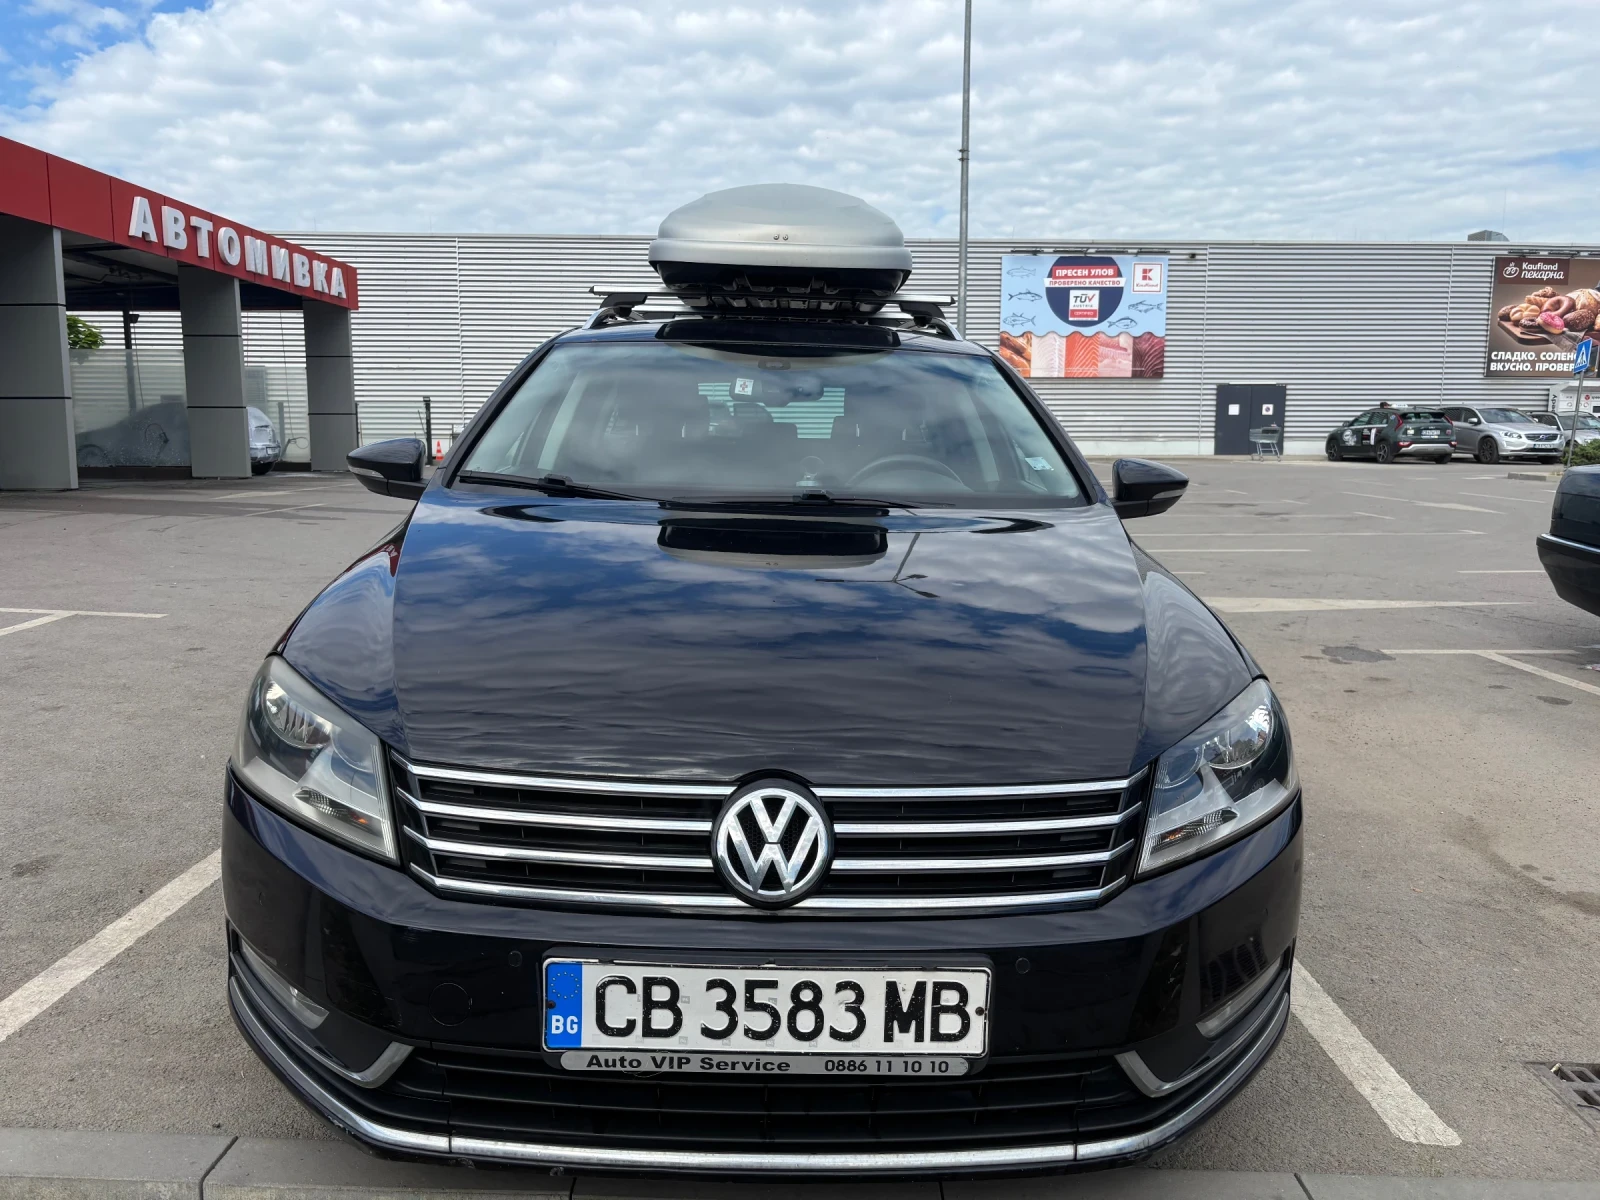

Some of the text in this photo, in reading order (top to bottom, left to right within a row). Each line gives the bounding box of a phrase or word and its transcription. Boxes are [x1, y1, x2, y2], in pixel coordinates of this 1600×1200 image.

[129, 196, 346, 299] АВТОМИВКА
[1522, 262, 1558, 271] Kaufland
[1055, 268, 1114, 277] ПРЕСЕН УЛОВ
[1521, 270, 1564, 280] пекарна
[1491, 352, 1537, 361] СЛАДКО.
[1490, 363, 1575, 371] ВКУСНО. ПРОВЕР
[596, 975, 971, 1043] CB 3583 MB
[551, 1015, 578, 1035] BG
[586, 1054, 949, 1074] Auto VIP Service 0886 11 10 10
